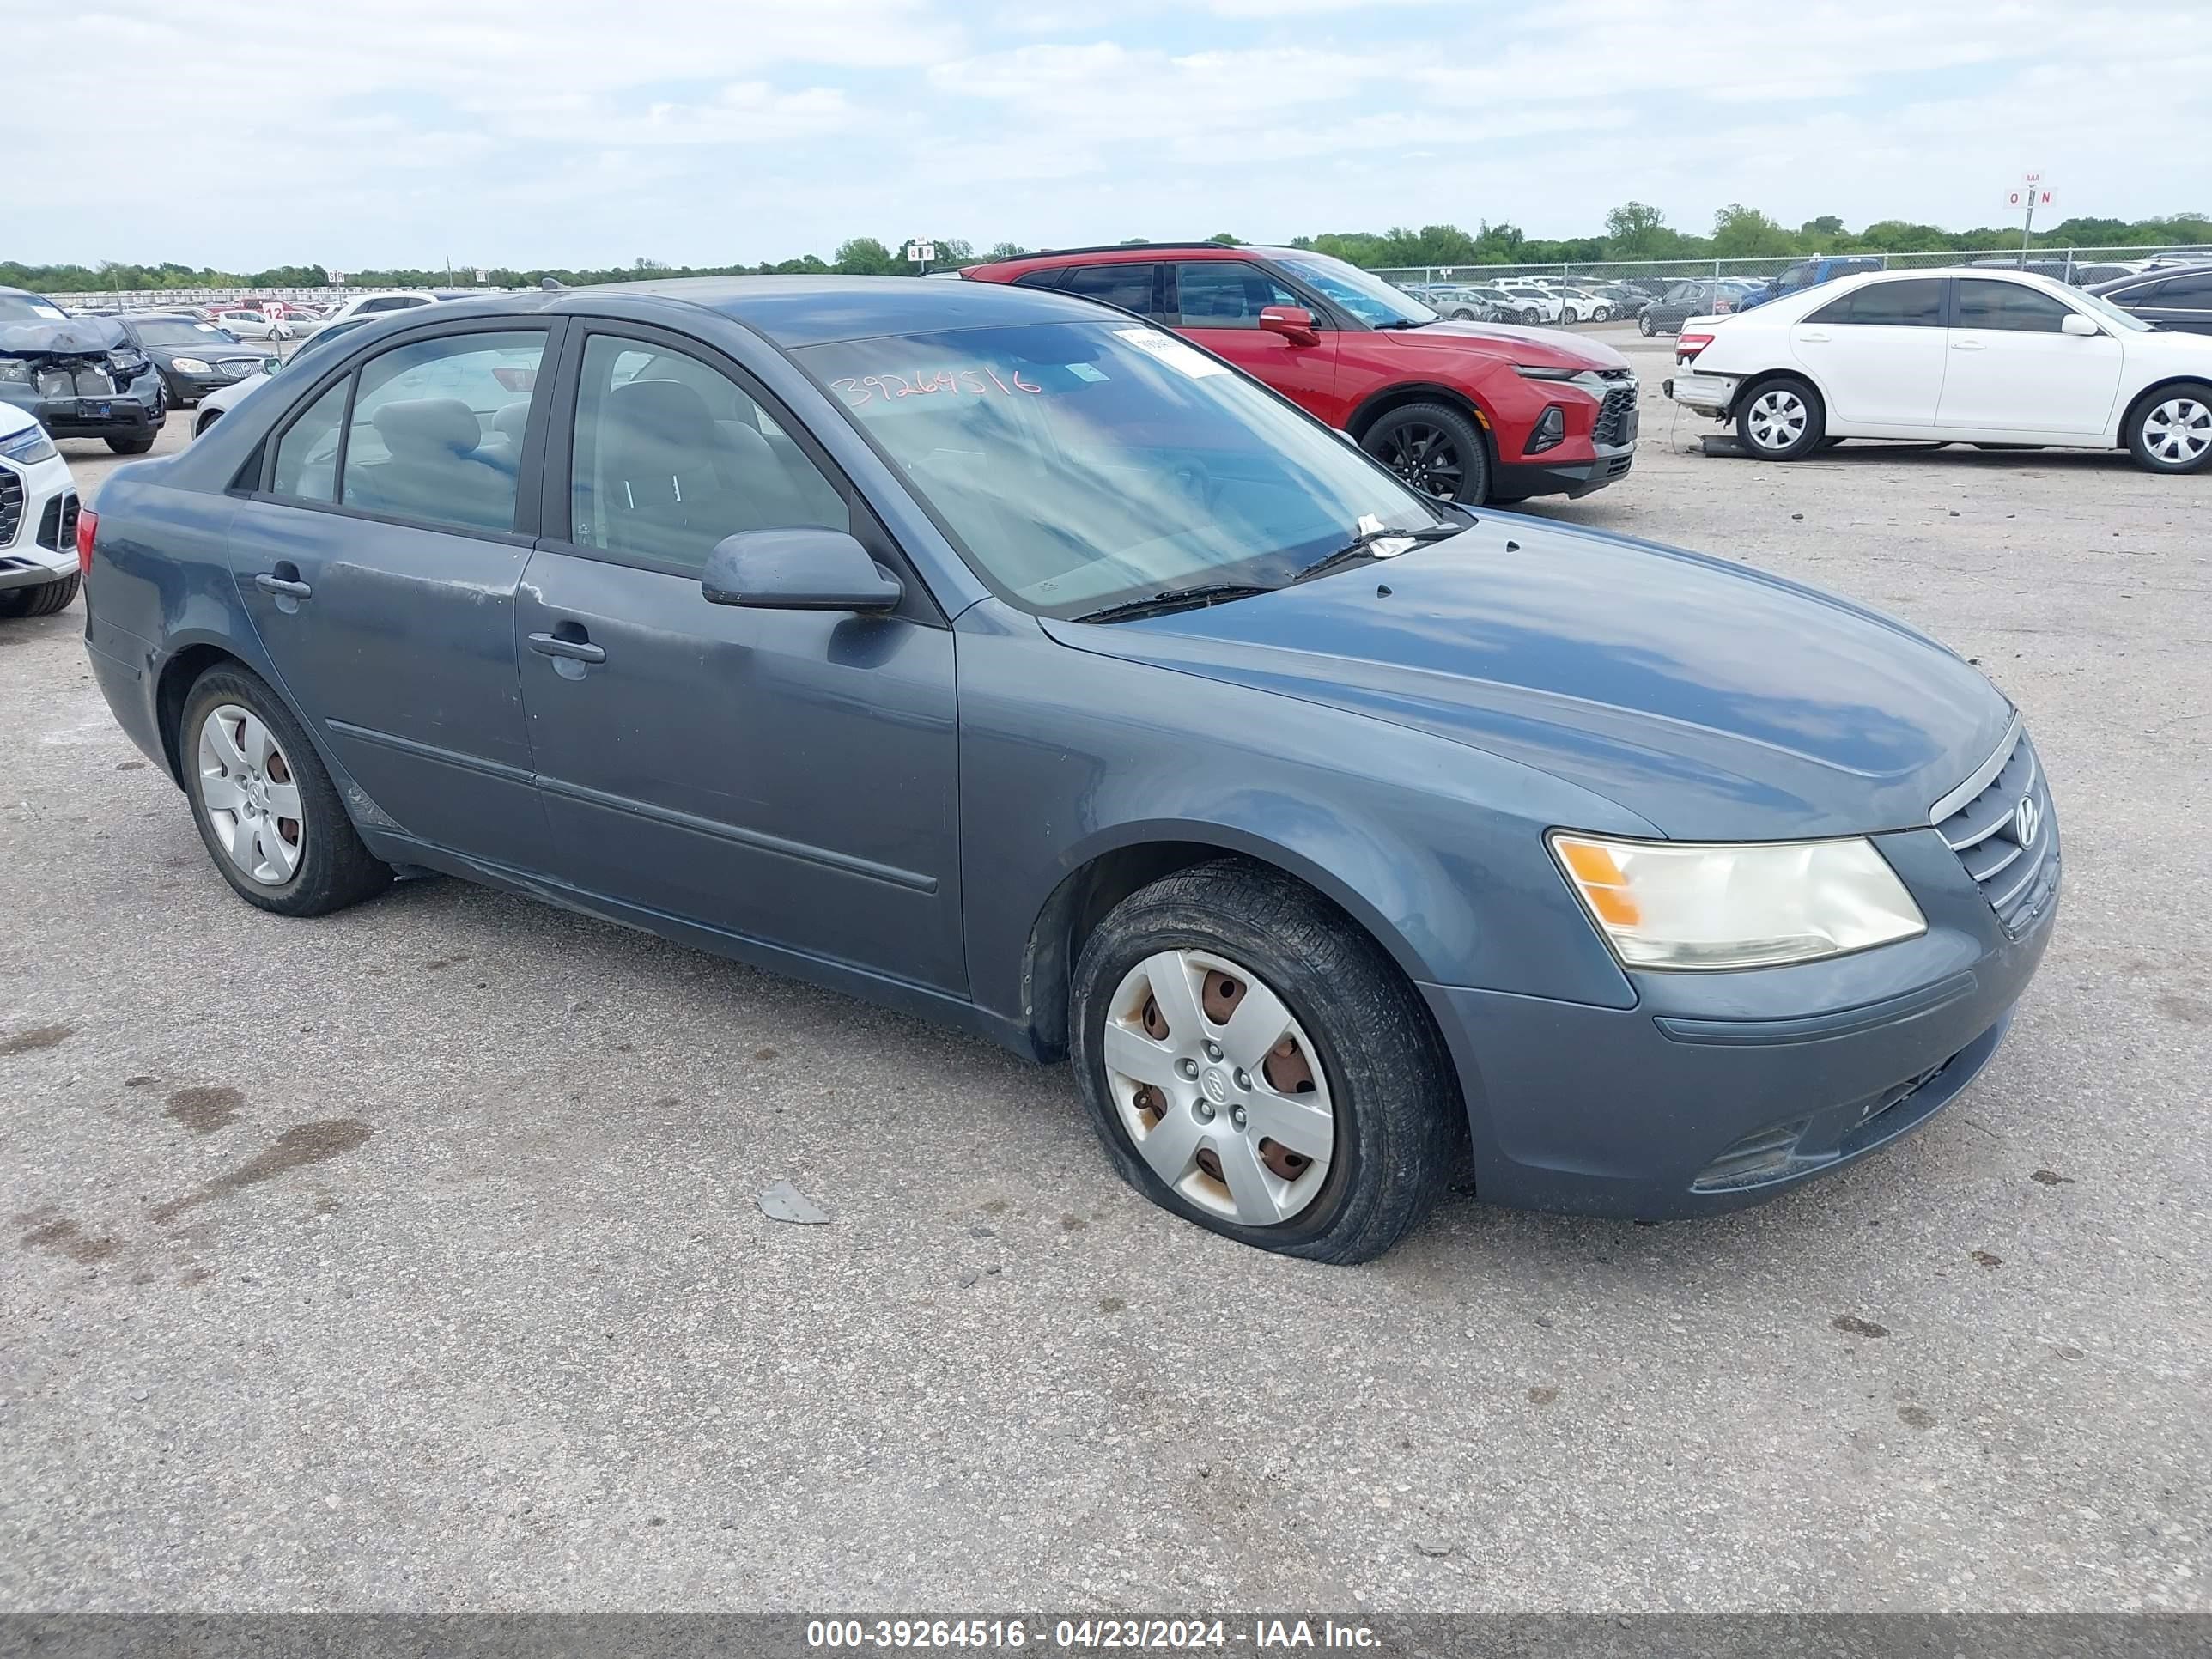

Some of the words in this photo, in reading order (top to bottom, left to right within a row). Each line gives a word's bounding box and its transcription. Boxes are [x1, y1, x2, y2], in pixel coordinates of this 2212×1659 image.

[2041, 191, 2051, 203] N
[329, 271, 335, 281] S
[265, 307, 283, 319] 12
[830, 367, 1042, 407] 39264516
